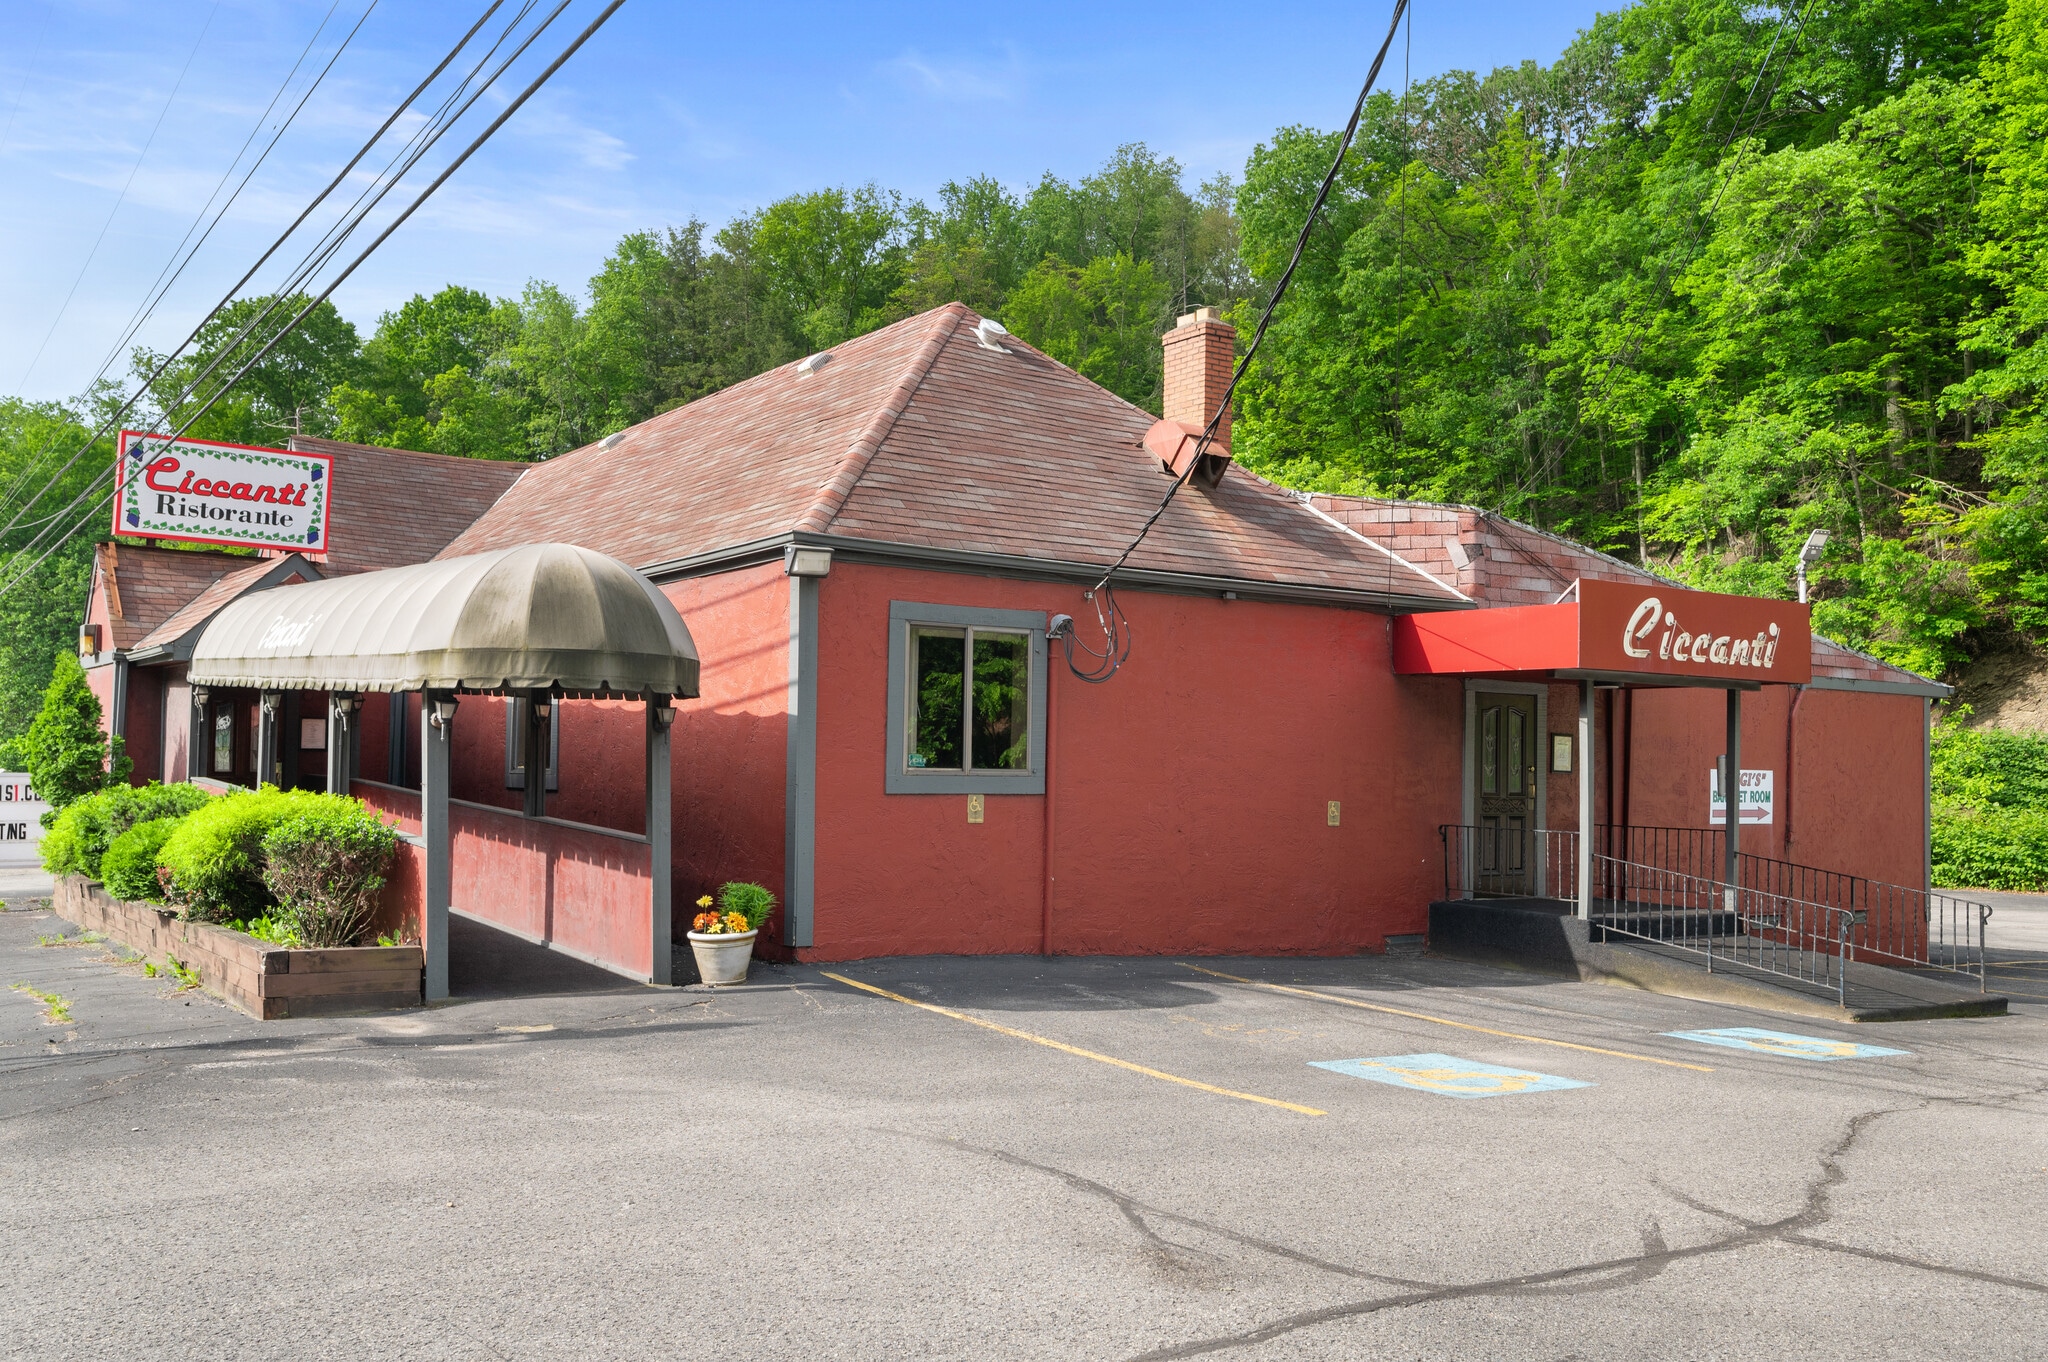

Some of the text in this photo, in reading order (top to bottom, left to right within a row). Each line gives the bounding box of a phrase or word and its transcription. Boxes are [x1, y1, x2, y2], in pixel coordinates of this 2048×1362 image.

[145, 456, 309, 507] Ciccanti
[154, 493, 294, 528] Ristorante
[1623, 597, 1780, 669] Ciccanti
[1750, 790, 1771, 803] ROOM
